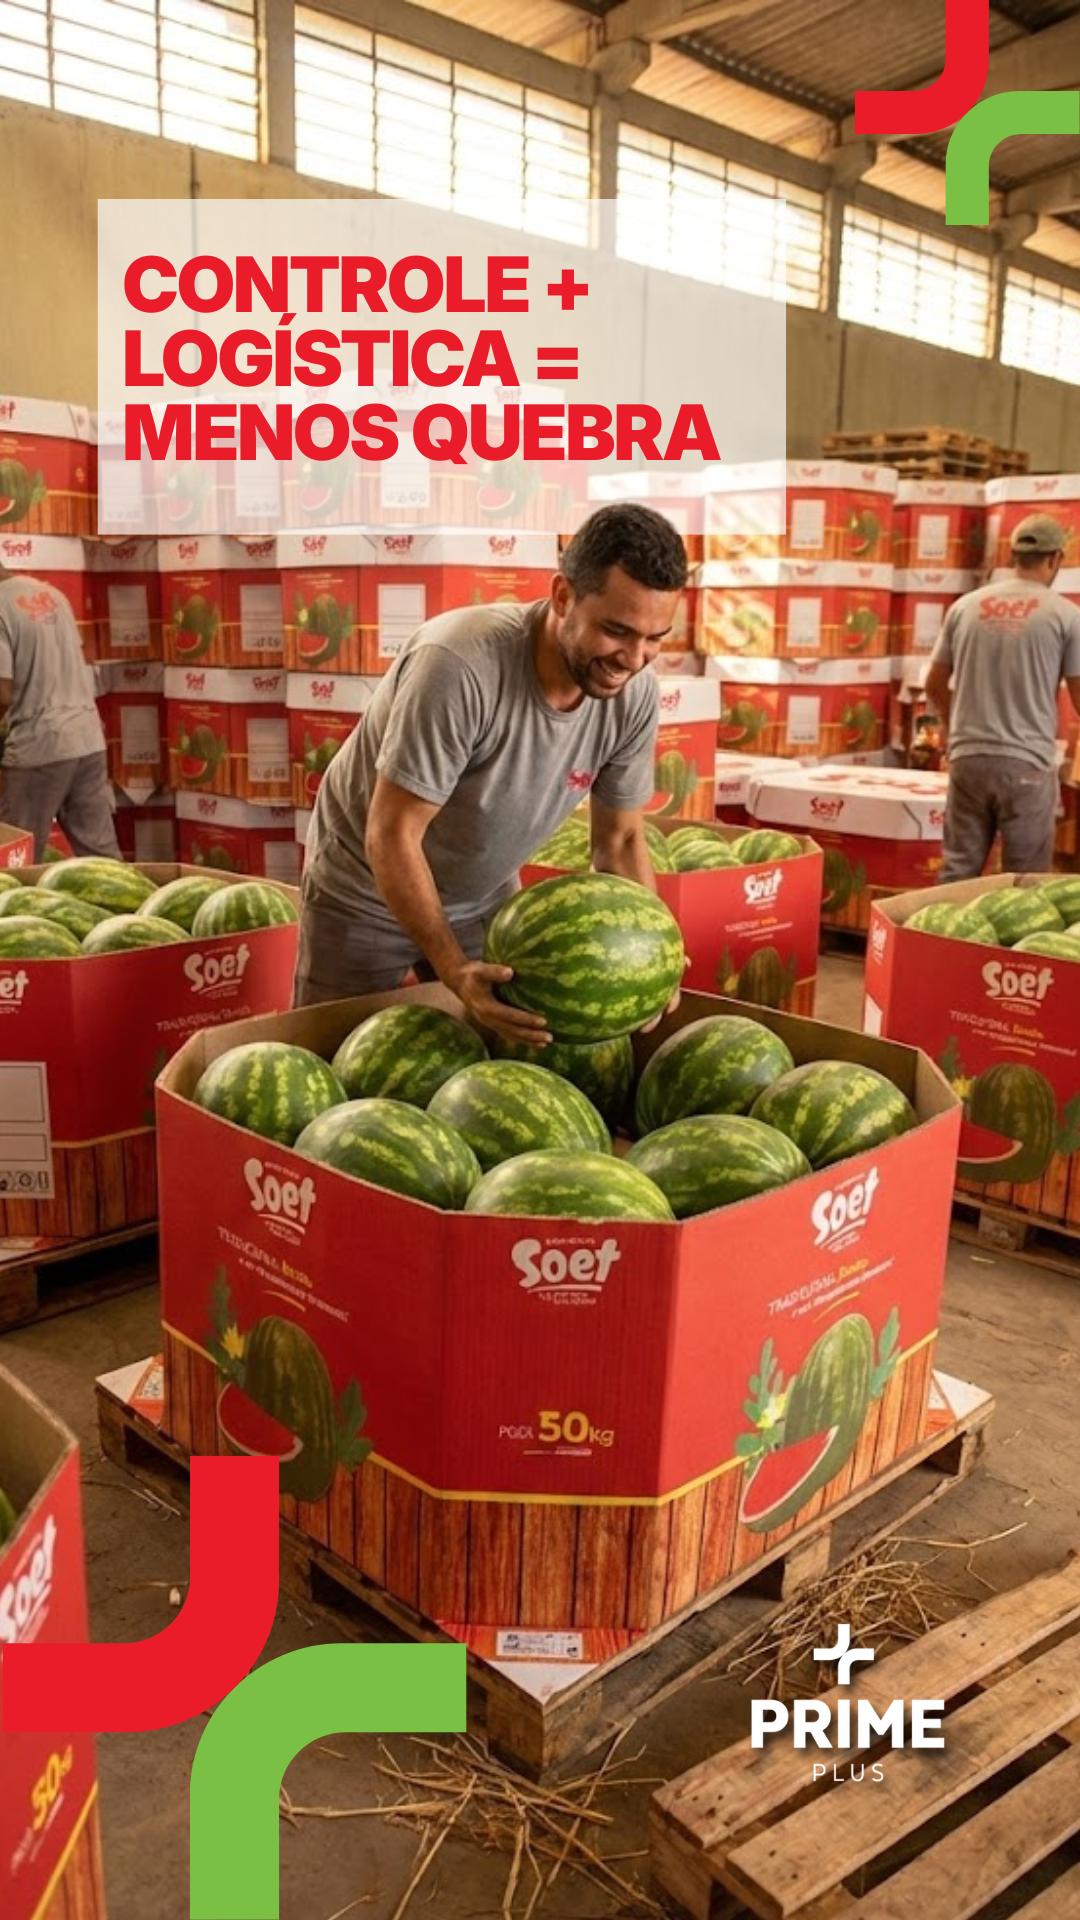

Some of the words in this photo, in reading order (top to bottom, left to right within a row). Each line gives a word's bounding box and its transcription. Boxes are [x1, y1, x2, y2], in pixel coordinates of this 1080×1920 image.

[184, 943, 250, 993] Soet
[981, 960, 1055, 1001] Soet
[243, 1157, 317, 1225] Soet
[811, 1166, 880, 1247] Soet
[511, 1238, 621, 1288] Soet
